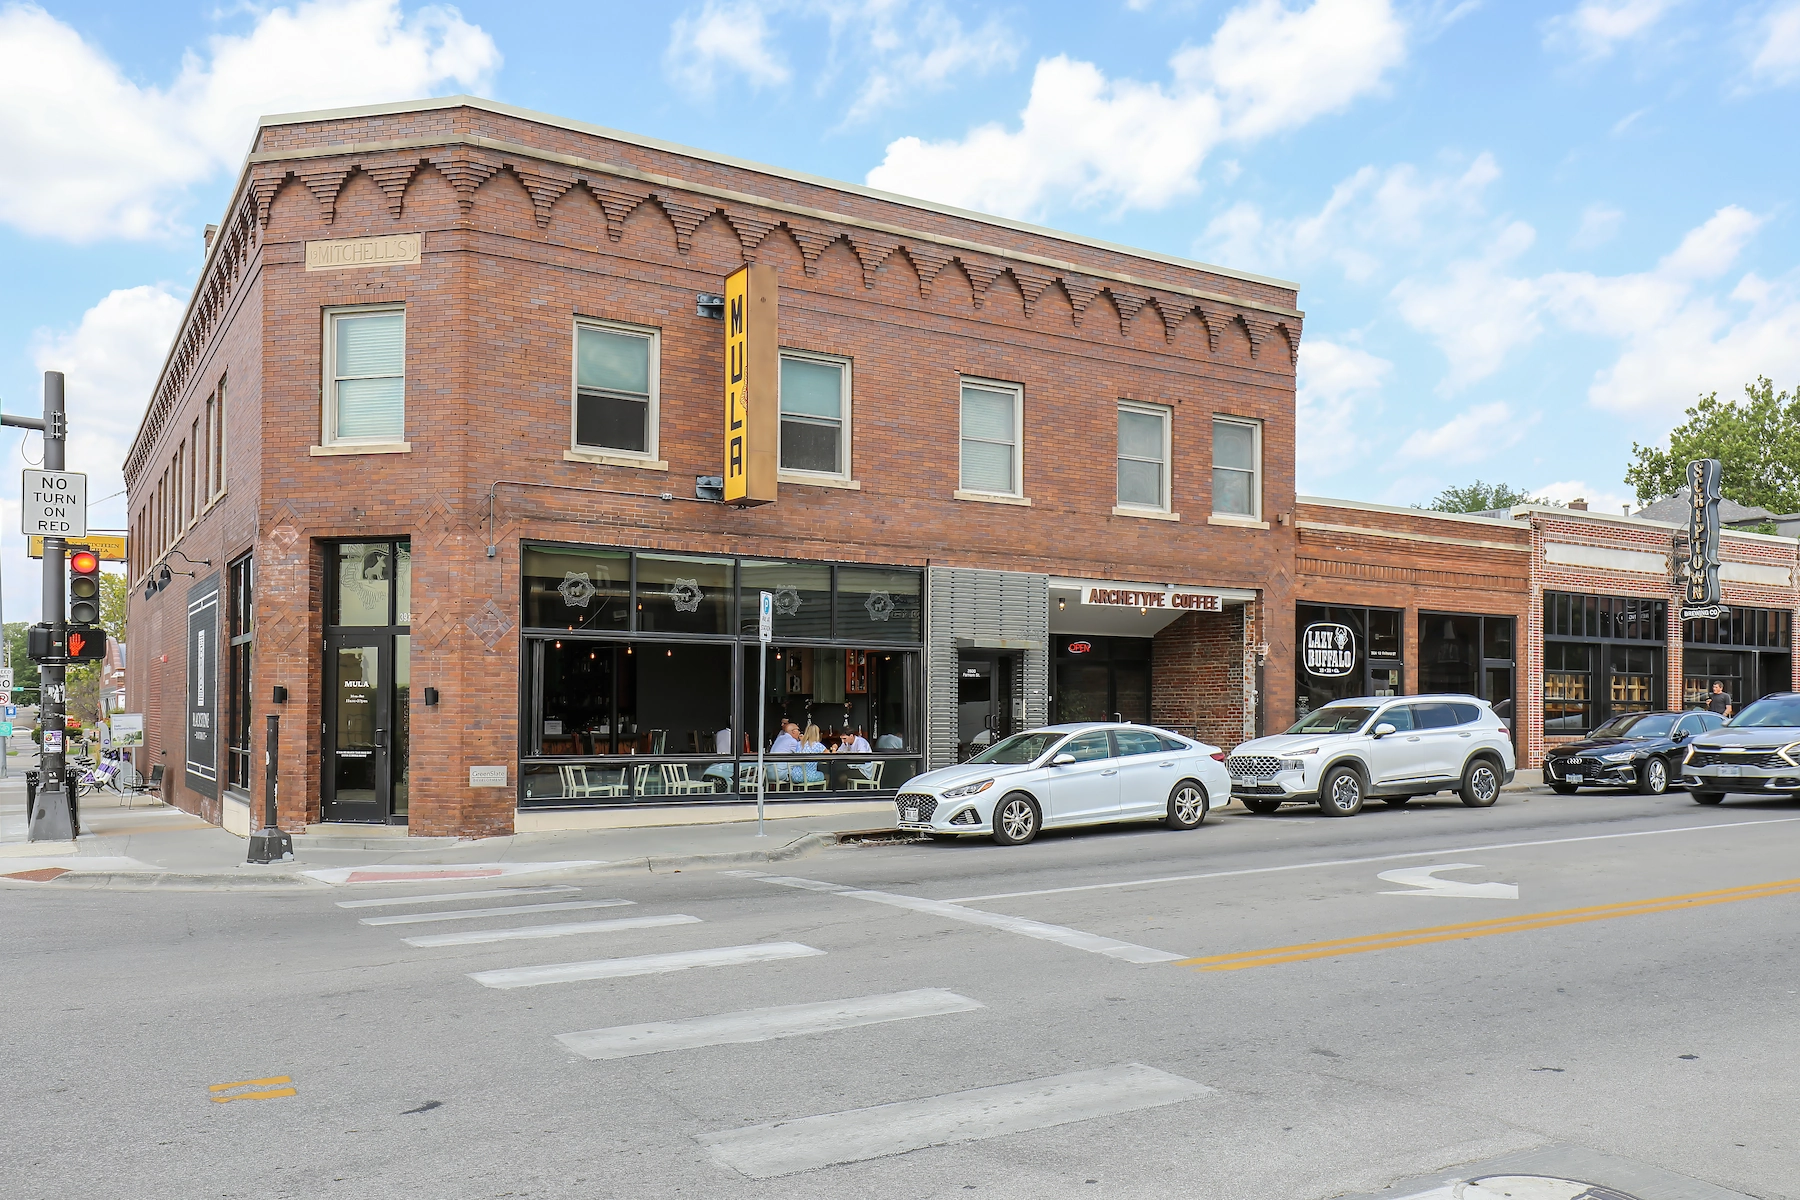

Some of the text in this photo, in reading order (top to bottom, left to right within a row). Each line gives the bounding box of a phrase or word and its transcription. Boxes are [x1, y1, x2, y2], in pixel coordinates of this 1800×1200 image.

[318, 240, 407, 264] MITCHELL'S
[730, 294, 743, 478] MULA
[42, 476, 67, 490] NO
[33, 491, 76, 505] TURN
[44, 506, 65, 518] ON
[38, 520, 70, 532] RED
[1088, 588, 1219, 610] ARCHETYPE COFFEE
[1683, 608, 1718, 617] BREWING CO
[1308, 631, 1333, 648] LAZY
[1069, 643, 1090, 652] OPEN
[1308, 649, 1351, 667] BUFFALO
[344, 680, 370, 688] MULA
